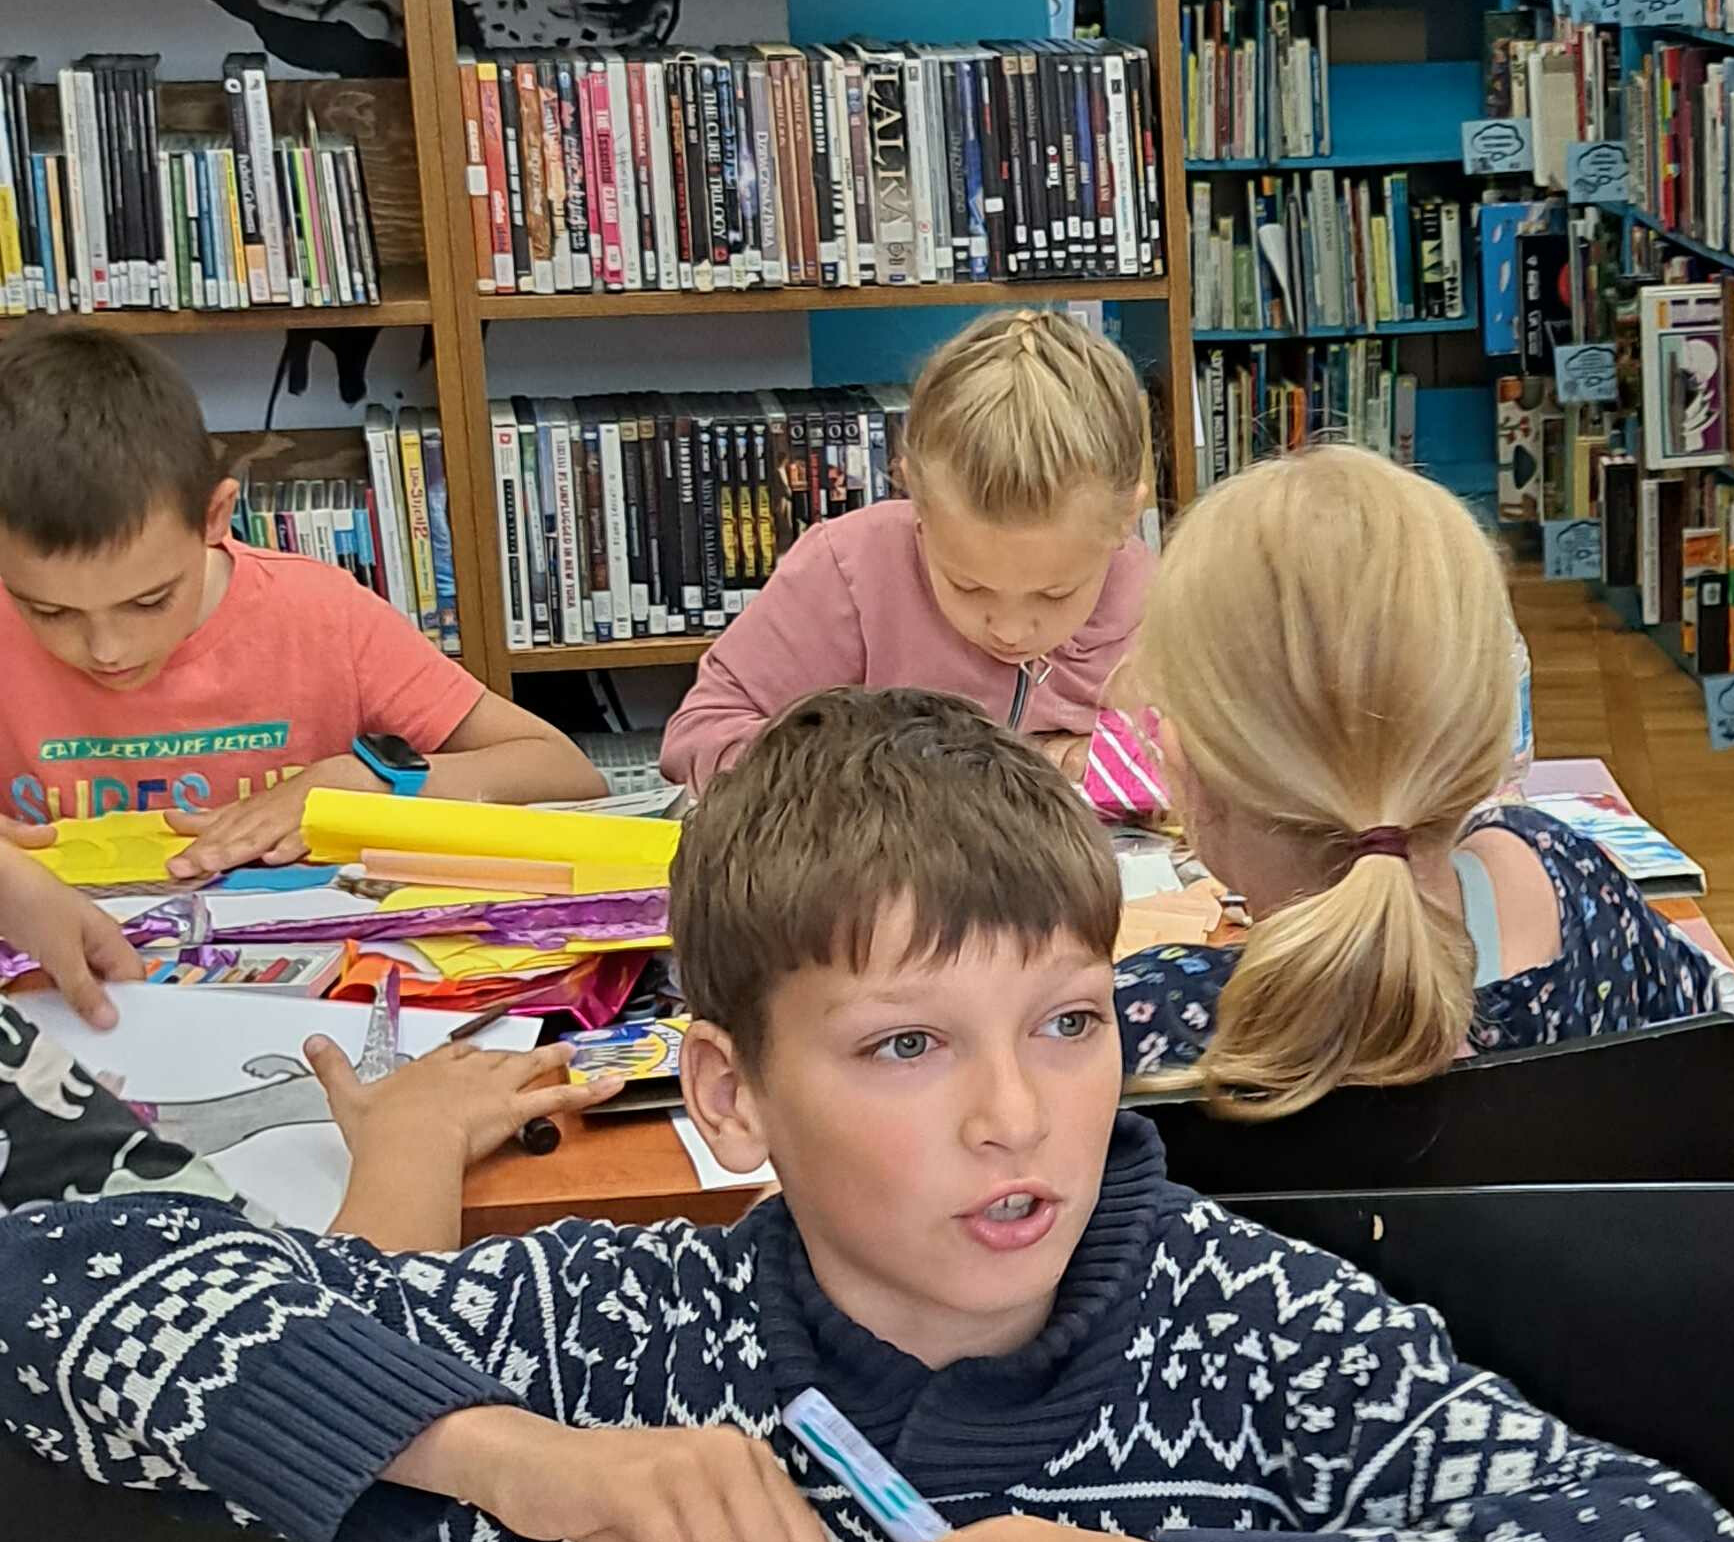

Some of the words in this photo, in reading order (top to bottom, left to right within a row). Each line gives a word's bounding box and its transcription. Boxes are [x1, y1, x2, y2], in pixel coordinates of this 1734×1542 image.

[703, 89, 719, 120] THE
[706, 122, 722, 163] CURE
[869, 71, 913, 232] LALKA
[709, 176, 728, 240] TRILOGY
[559, 484, 572, 544] UNPLUGGED
[41, 741, 80, 759] EAT
[87, 741, 150, 758] SLEEP
[154, 735, 207, 756] SURF
[213, 730, 286, 750] REPEAT
